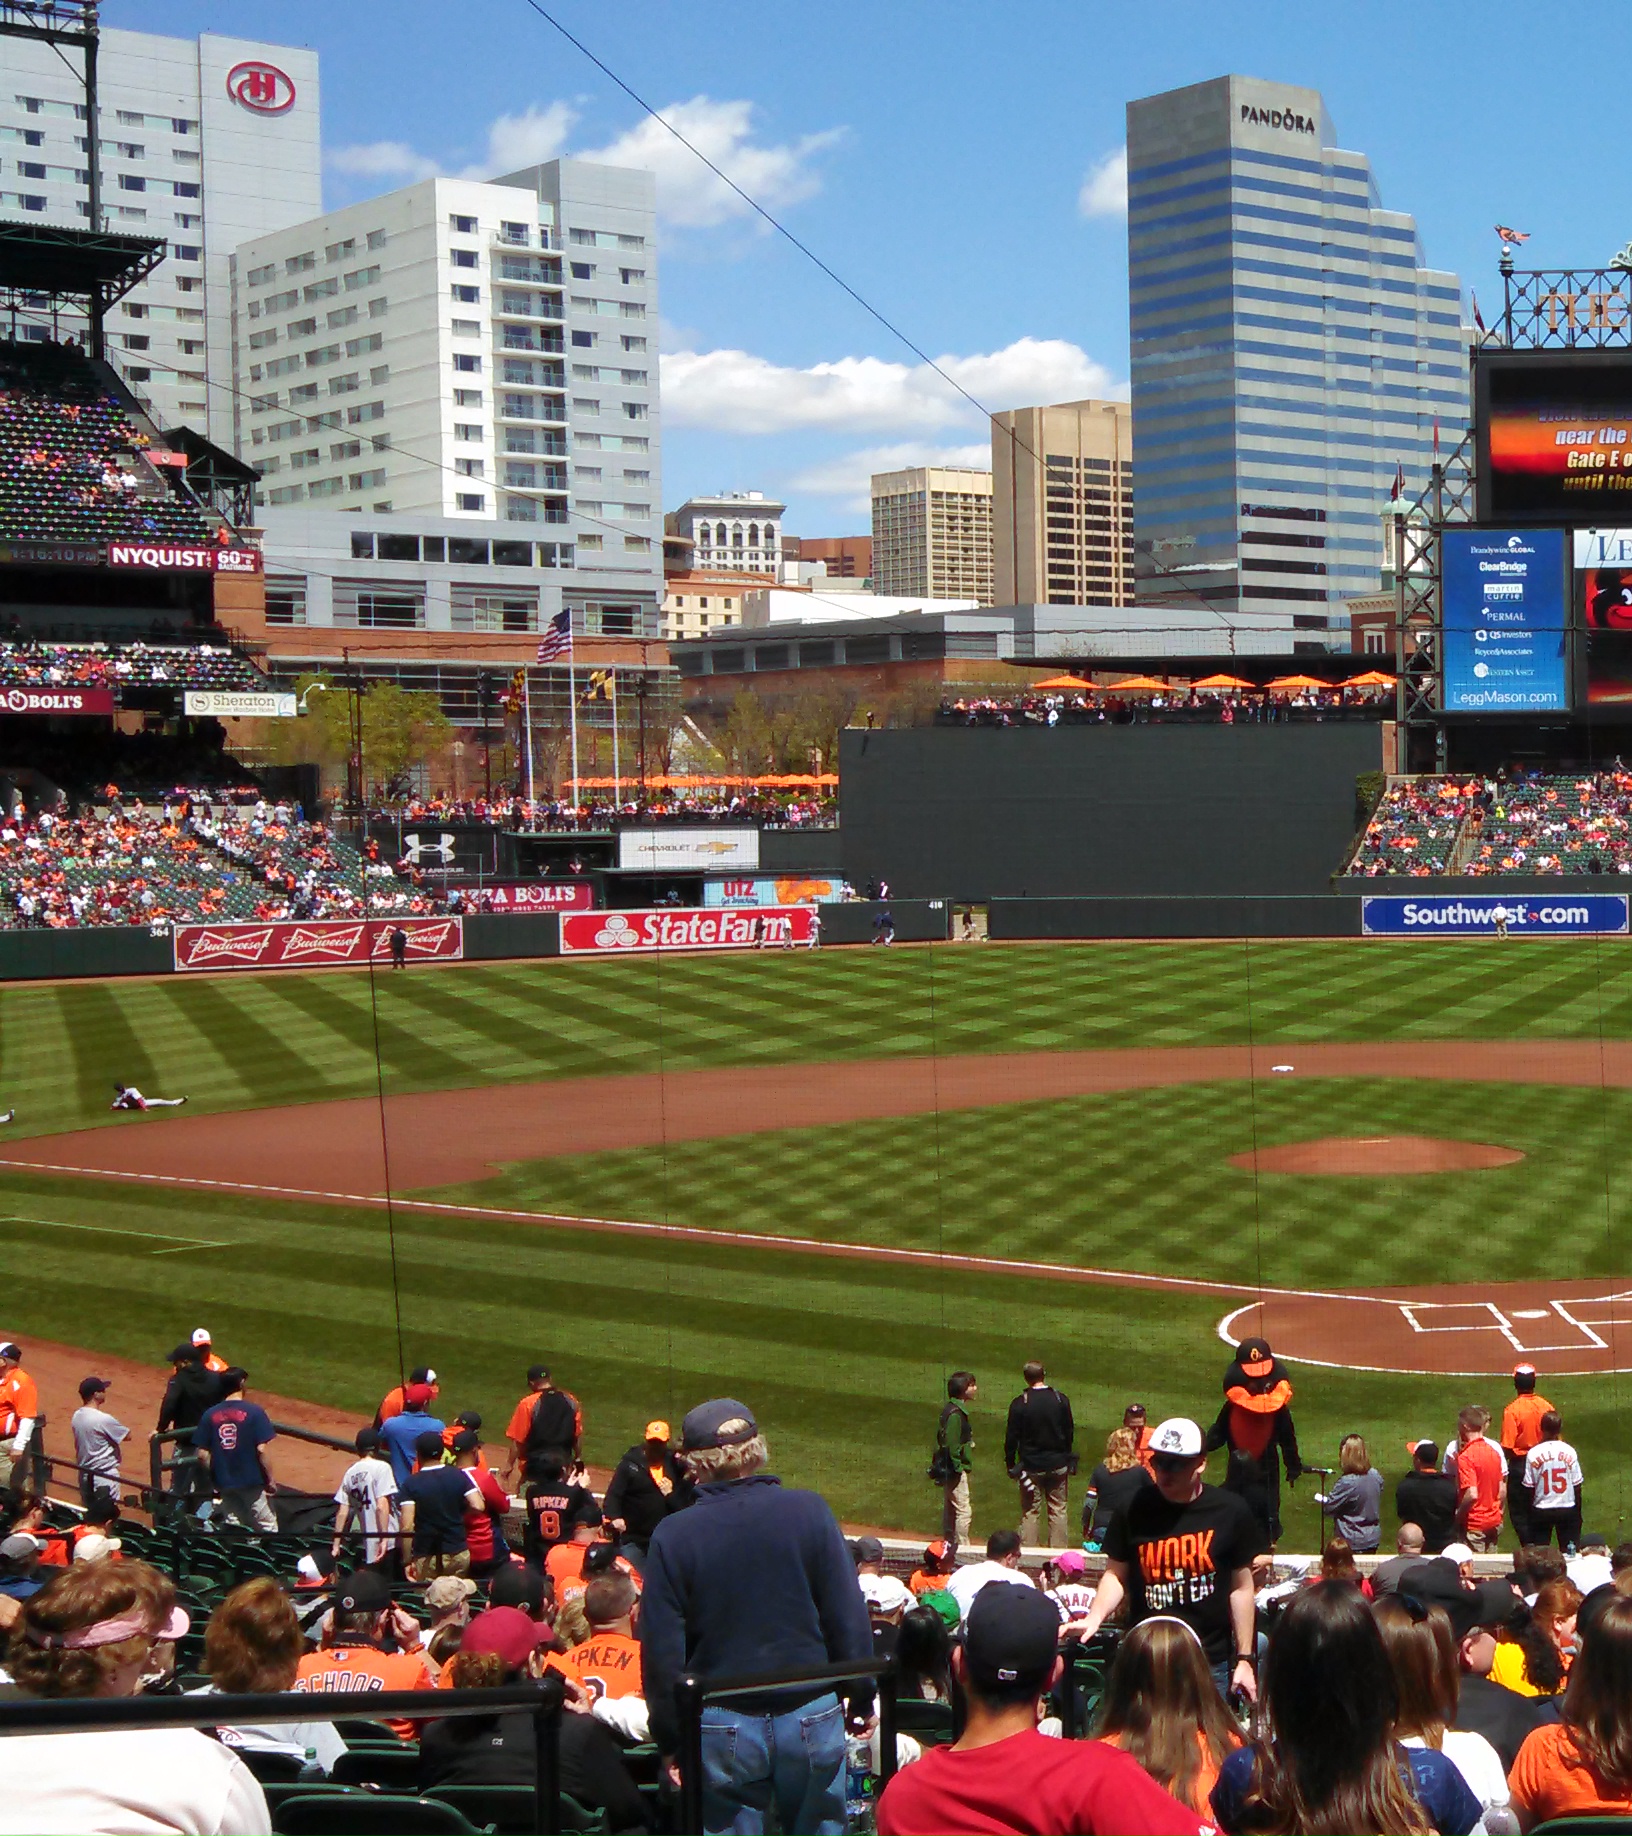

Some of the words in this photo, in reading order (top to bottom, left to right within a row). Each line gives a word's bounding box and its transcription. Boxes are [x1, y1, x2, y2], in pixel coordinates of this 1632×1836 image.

[1241, 105, 1315, 135] PANDORA
[1540, 293, 1628, 329] THE
[1556, 429, 1594, 445] near
[1599, 428, 1627, 444] the
[1567, 451, 1605, 468] Gate
[1609, 451, 1620, 467] E
[1563, 474, 1604, 490] until
[112, 547, 206, 567] NYQUIST
[217, 550, 241, 564] 60
[1479, 561, 1527, 572] ClearBridge
[1487, 613, 1526, 621] PERMAL
[29, 695, 82, 709] BOLI'S
[213, 694, 275, 706] Sheraton
[1453, 690, 1558, 705] LeggMason.com
[638, 844, 690, 852] CHEVROLET
[515, 885, 576, 904] BOLI'S
[929, 901, 943, 909] 410
[1403, 902, 1588, 924] Southwst.com
[150, 926, 169, 938] 364
[189, 936, 270, 953] Budweiser
[282, 934, 360, 951] Budweiser
[374, 931, 448, 948] Bweiser
[1541, 1468, 1567, 1495] 15
[533, 1496, 569, 1510] RIPKEN
[540, 1510, 560, 1539] 8
[1138, 1529, 1215, 1583] WORK
[1064, 1591, 1092, 1608] HAR
[1145, 1580, 1185, 1611] DON'T
[1190, 1572, 1217, 1603] EAT
